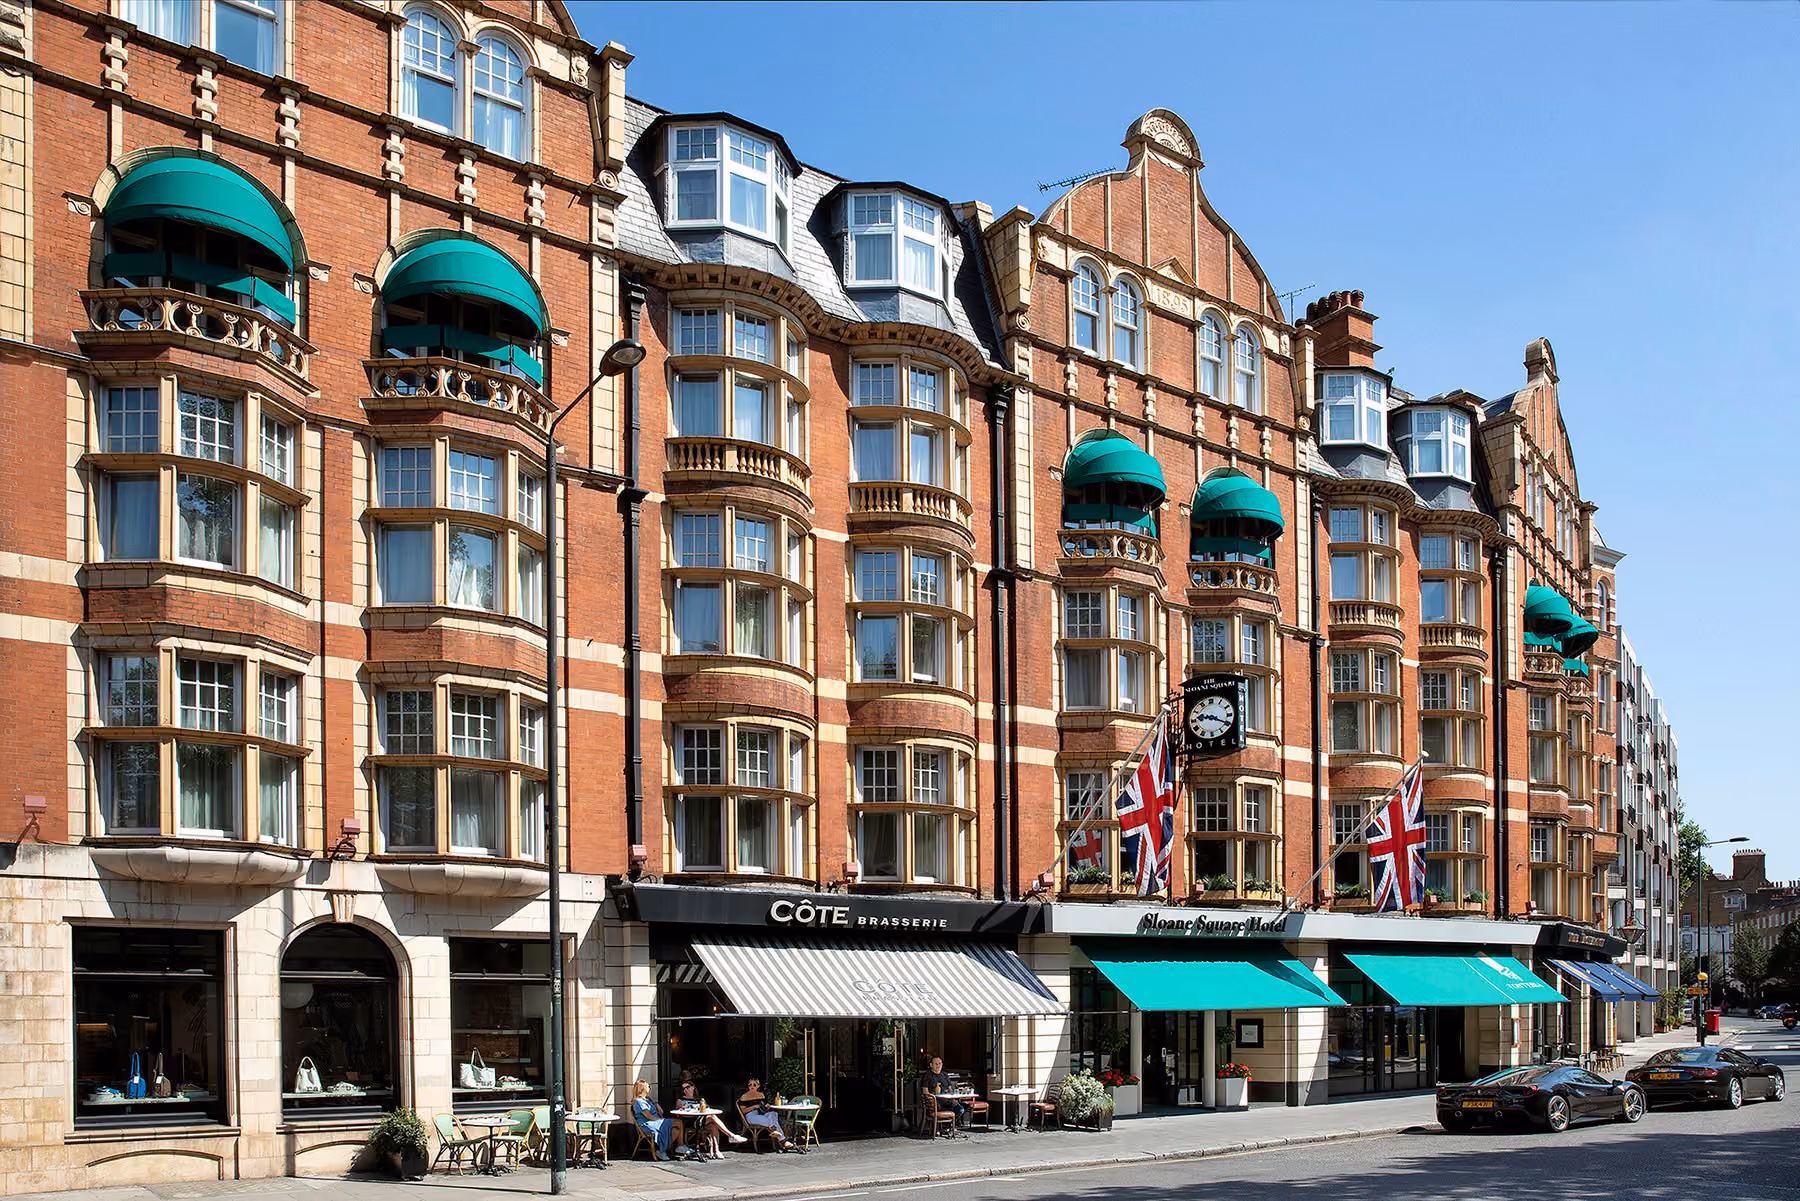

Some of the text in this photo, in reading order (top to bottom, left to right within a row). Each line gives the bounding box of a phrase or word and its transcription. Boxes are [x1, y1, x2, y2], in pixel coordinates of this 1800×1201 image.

[1185, 738, 1236, 750] HOTEL
[770, 899, 948, 928] CÔTE BRASSERIE
[1143, 912, 1288, 934] Sloane Square Hotel
